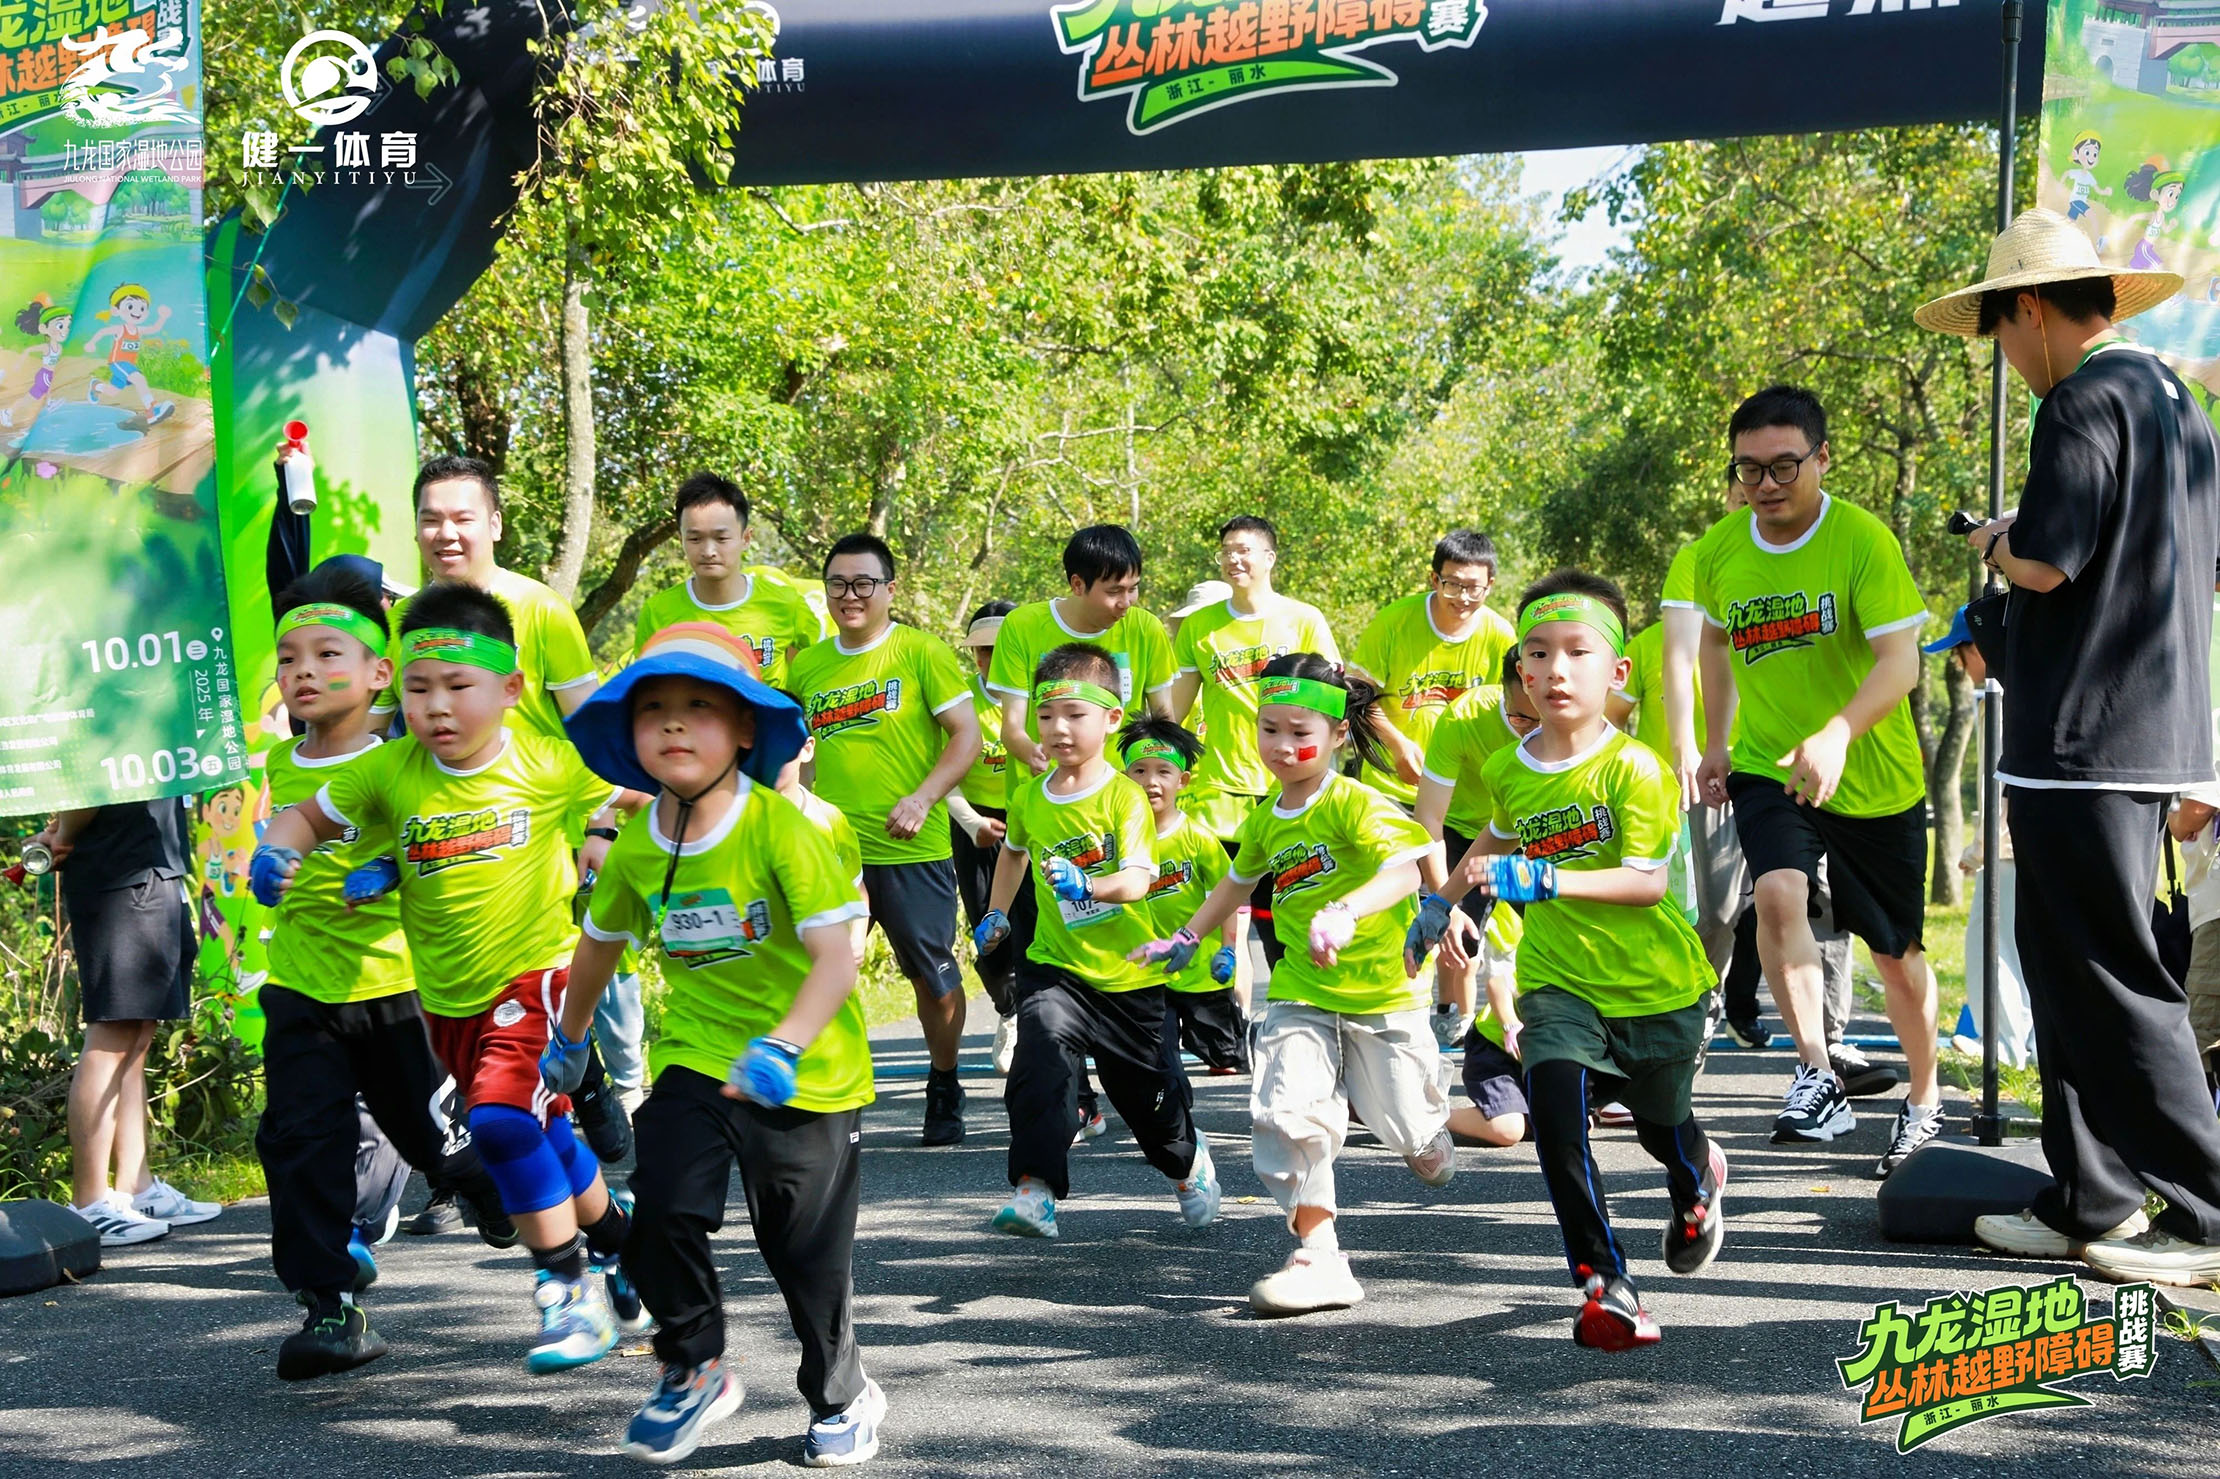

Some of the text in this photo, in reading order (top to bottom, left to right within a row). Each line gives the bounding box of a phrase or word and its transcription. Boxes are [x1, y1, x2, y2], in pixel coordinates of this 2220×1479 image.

[1727, 594, 1805, 635] 九龙湿地
[82, 631, 182, 673] 10.01
[213, 647, 242, 771] 九龙国家湿地公园
[100, 747, 201, 790] 10.03
